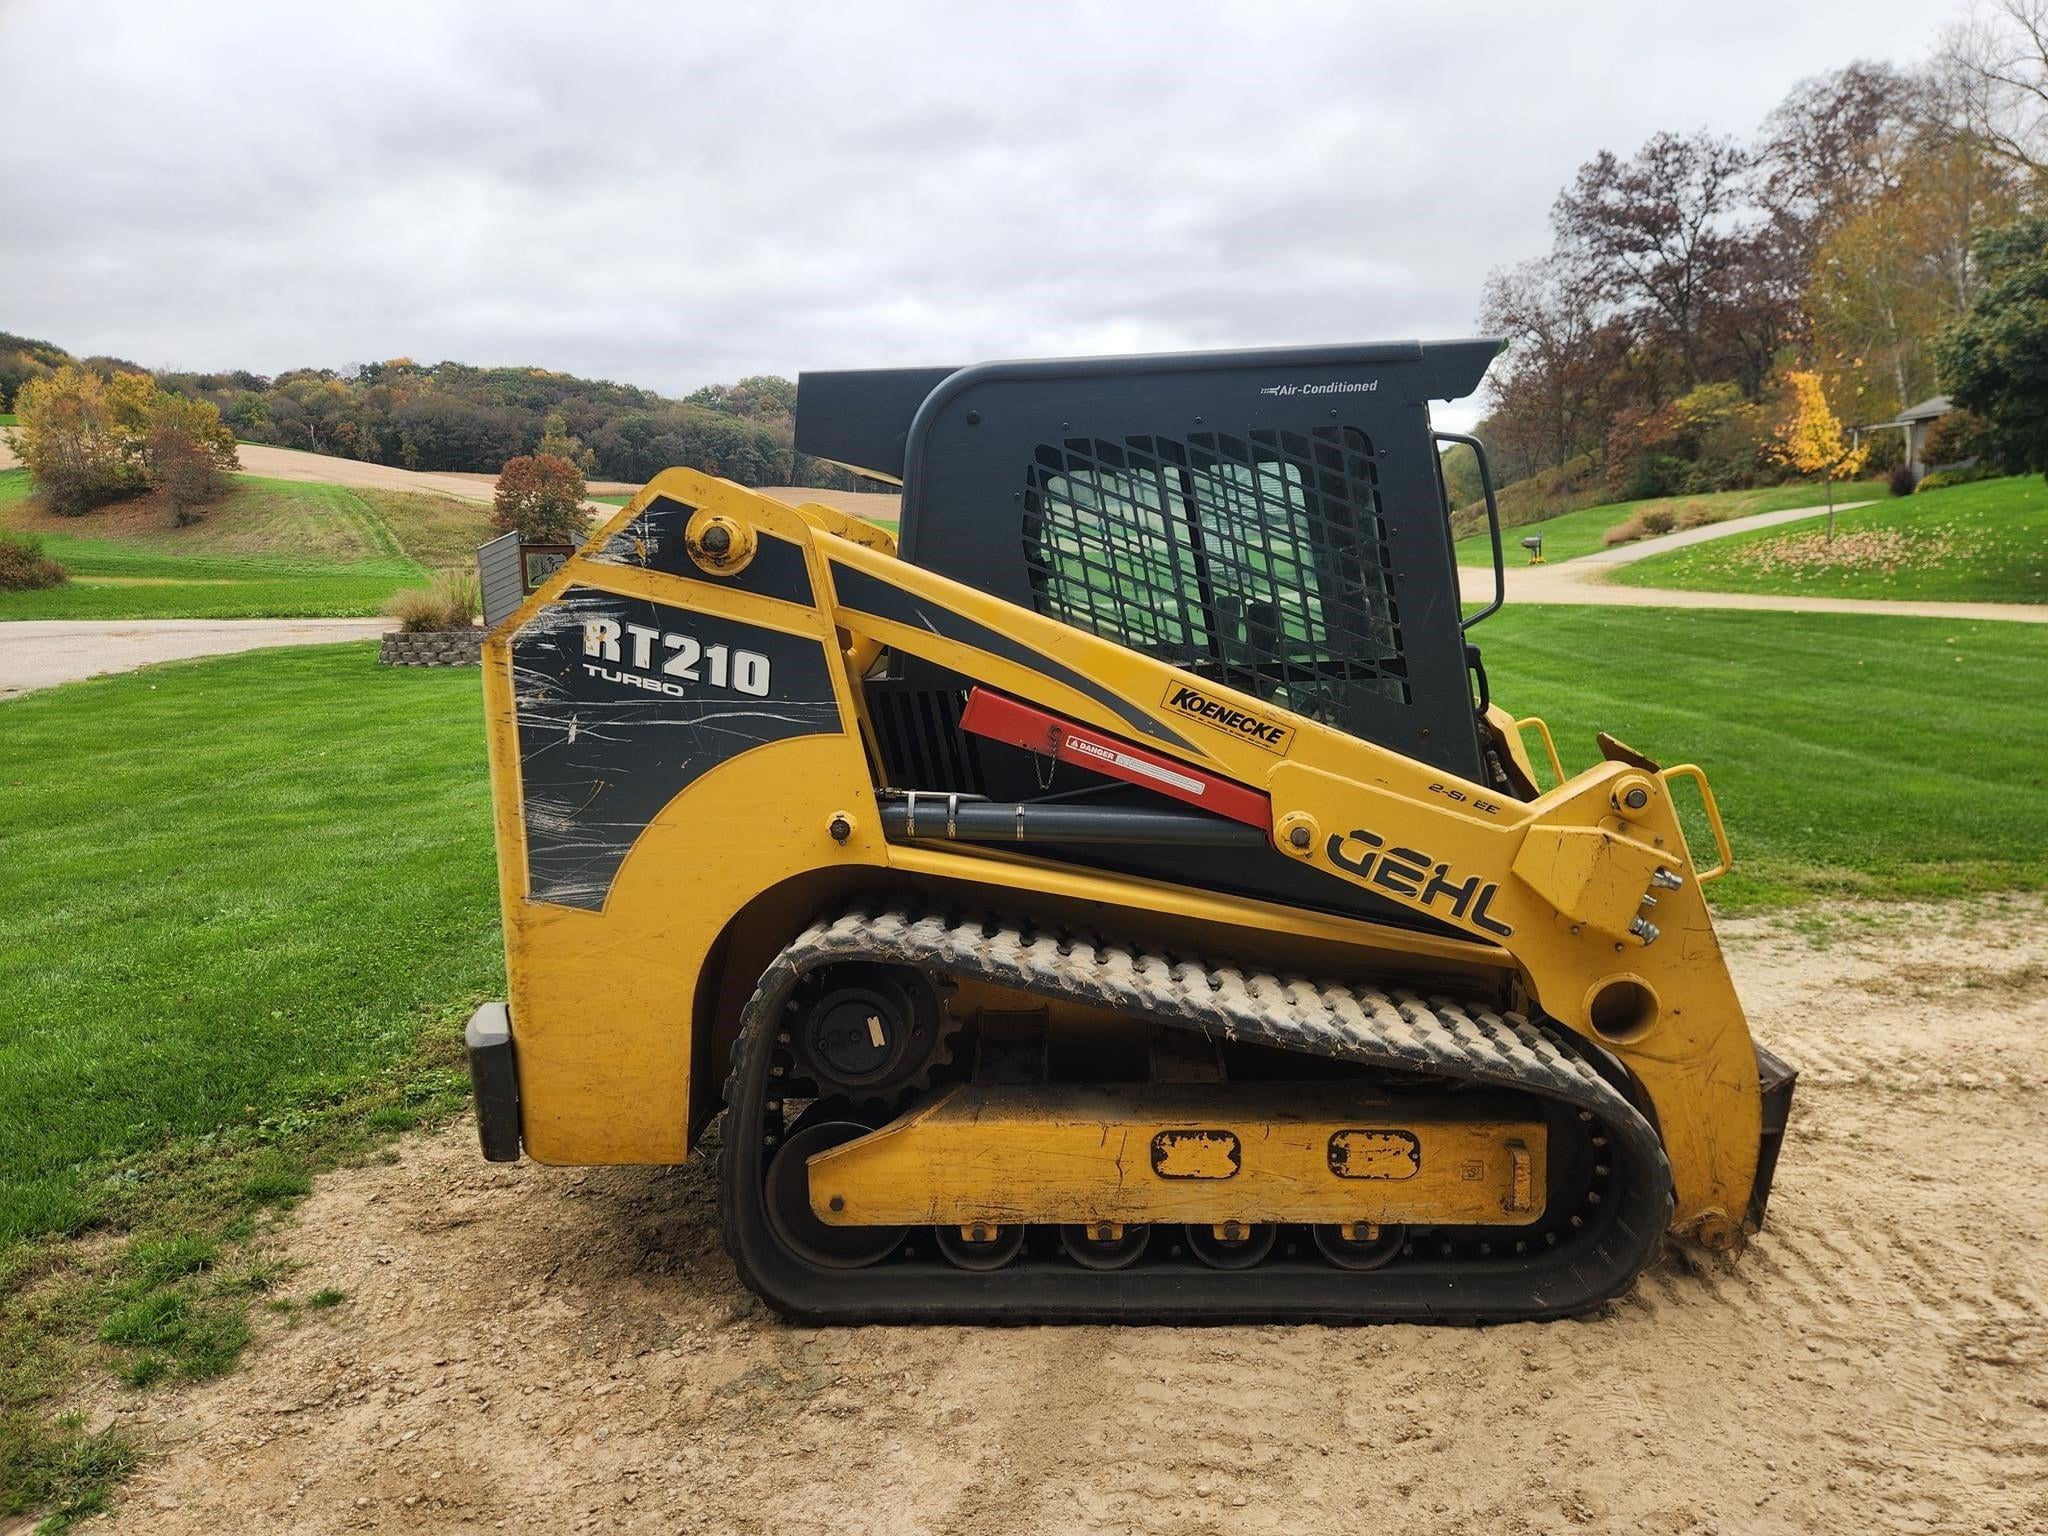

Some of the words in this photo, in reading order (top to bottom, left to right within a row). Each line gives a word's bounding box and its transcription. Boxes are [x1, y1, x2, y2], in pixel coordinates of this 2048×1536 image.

[1279, 380, 1378, 396] Air-Conditioned
[583, 617, 770, 697] RT210
[582, 663, 684, 697] TURBO
[1170, 687, 1285, 744] KOENECKE
[1079, 743, 1115, 760] DANGER
[1326, 829, 1513, 937] GEHL
